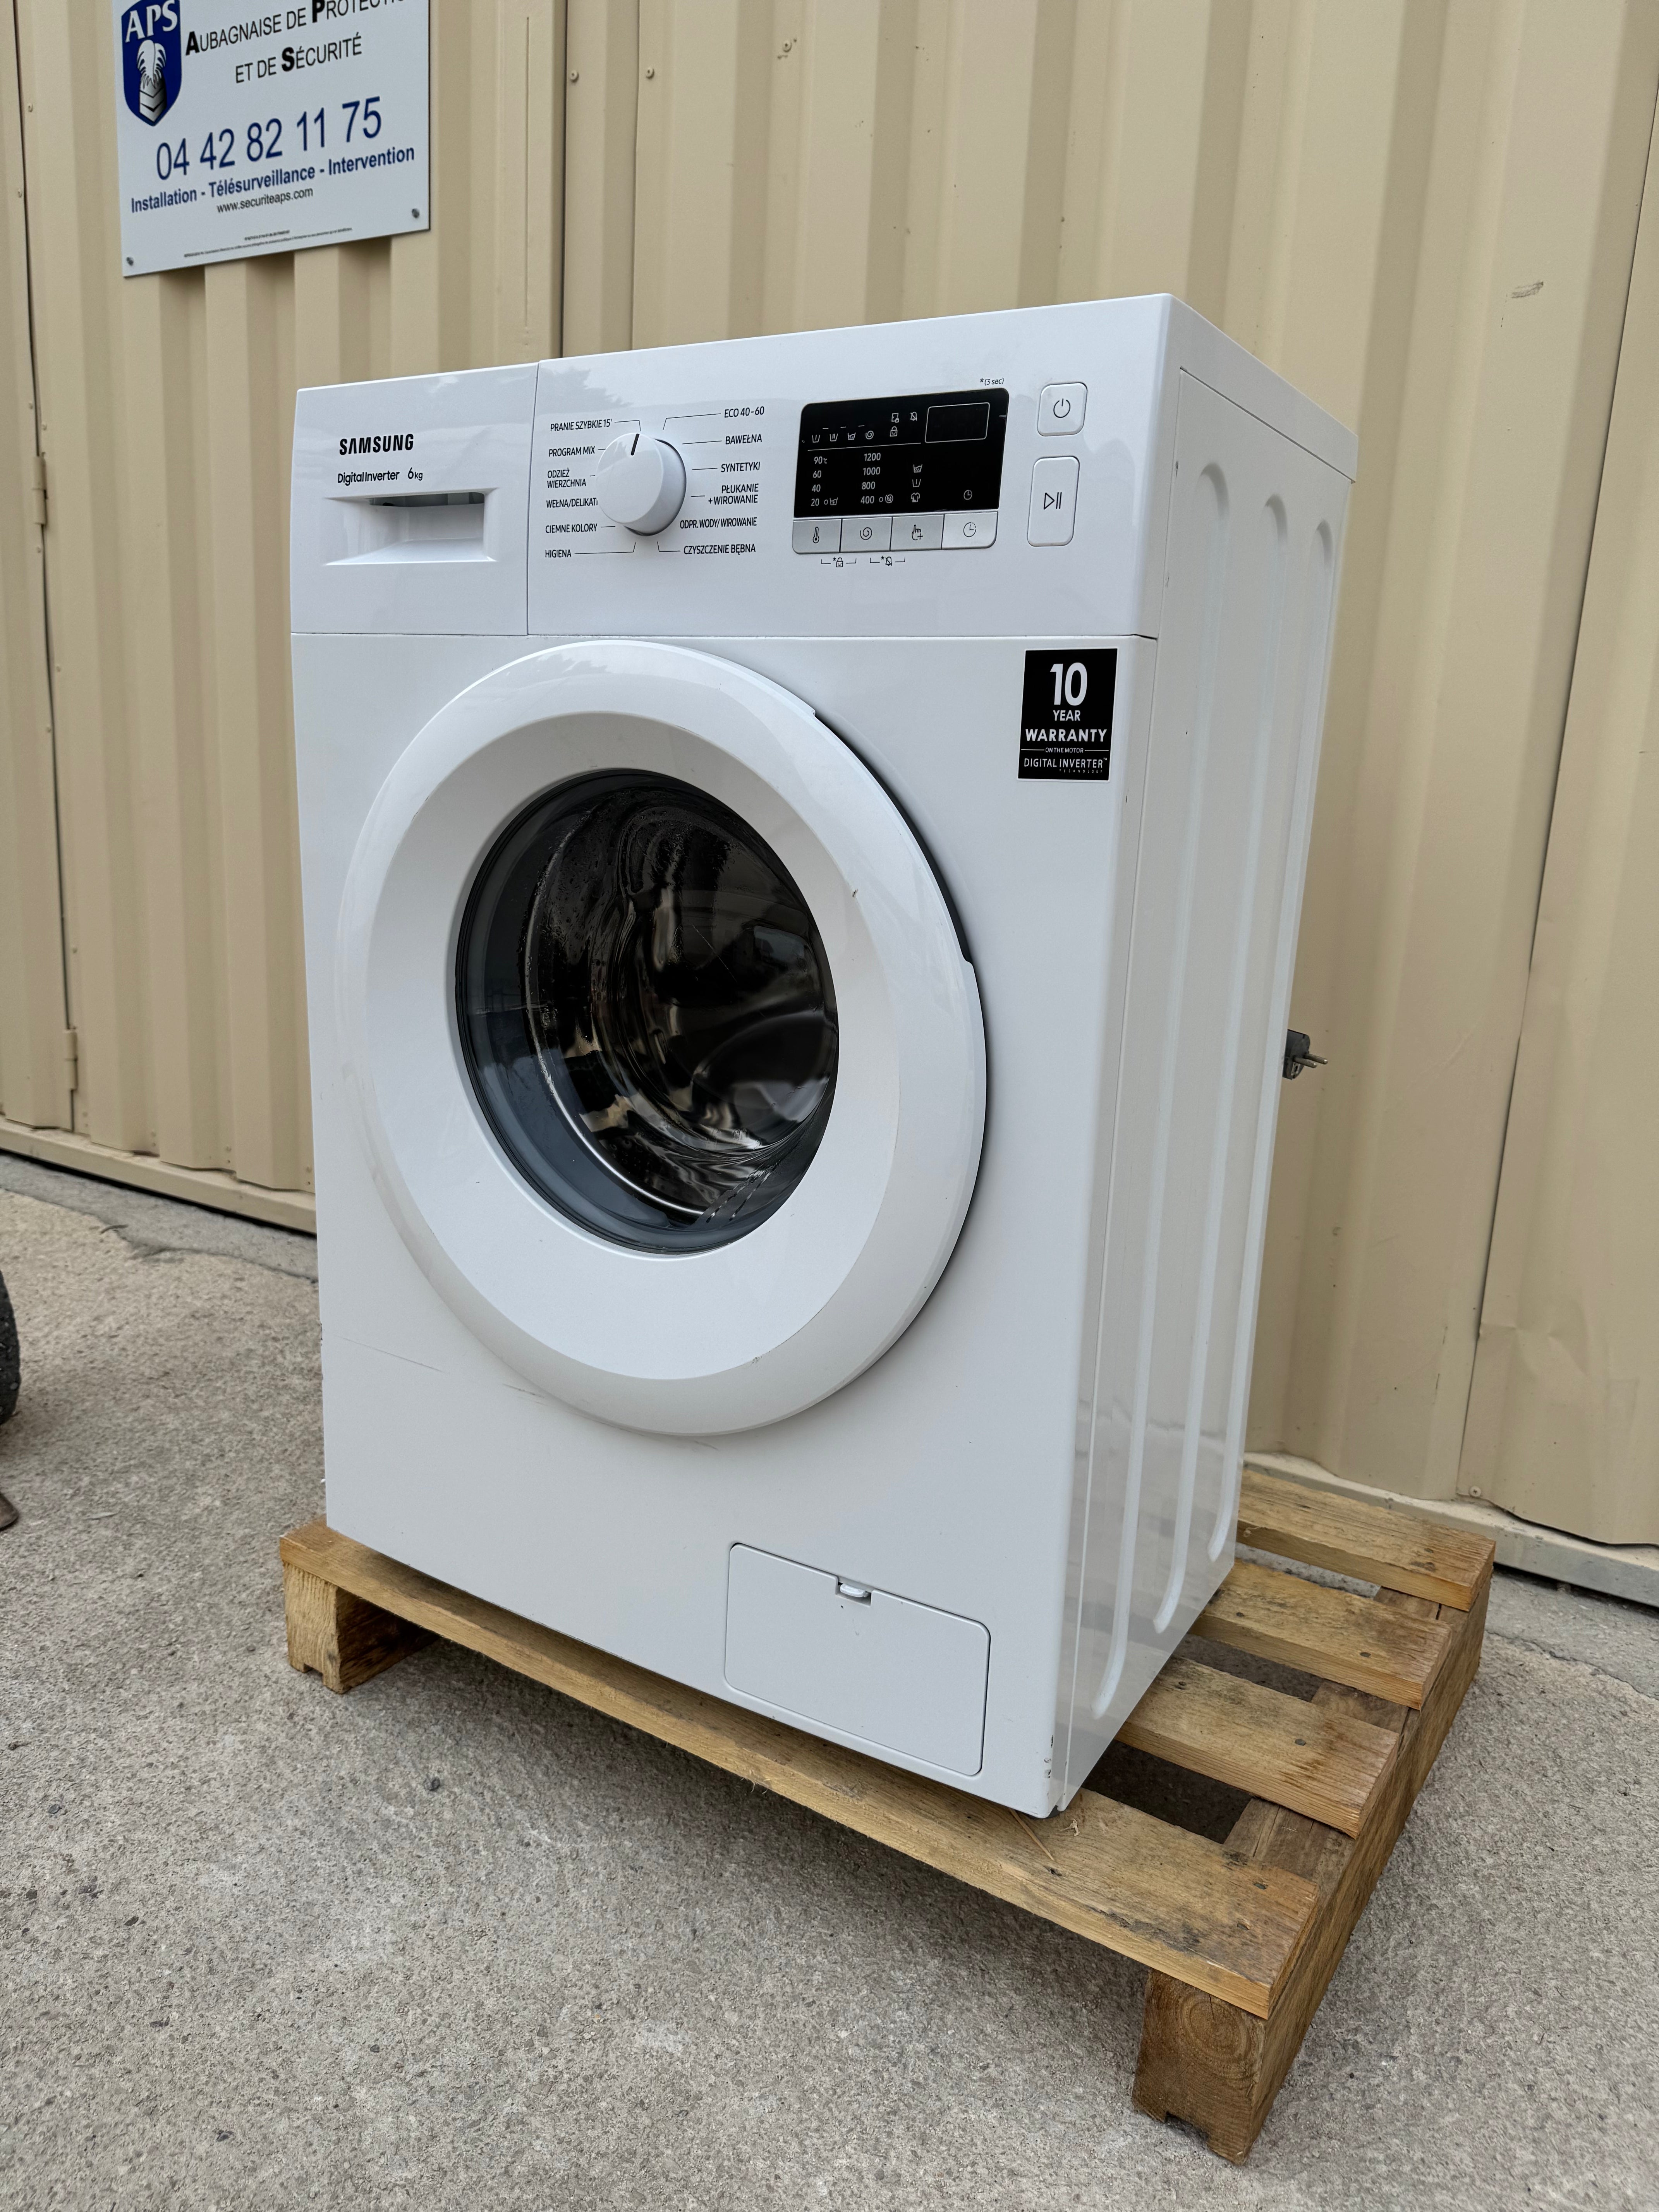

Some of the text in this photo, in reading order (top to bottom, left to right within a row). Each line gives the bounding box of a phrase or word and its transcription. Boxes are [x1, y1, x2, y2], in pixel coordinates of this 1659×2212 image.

[125, 0, 178, 43] APS
[185, 14, 282, 55] AUBAGNAISE
[287, 7, 307, 29] DE
[236, 32, 362, 83] ET DE SÉCURITÉ
[156, 96, 382, 181] 04 42 82 11 75
[131, 188, 197, 213] Installation
[208, 167, 316, 198] Télésurveillance
[328, 146, 415, 176] Intervention
[217, 187, 313, 213] www.securiteaps.com
[724, 409, 739, 418] ECO
[550, 422, 574, 431] PRANIE
[575, 419, 603, 430] SZYBKIE
[339, 433, 414, 455] SAMSUNG
[725, 434, 762, 445] BAWEŁNA
[549, 446, 595, 457] PROGRAM MIX
[864, 453, 881, 461] 1200
[548, 467, 570, 478] ODZIEŻ
[721, 462, 760, 472] SYNTETYKI
[863, 467, 881, 476] 1000
[813, 470, 822, 478] 60
[547, 478, 586, 488] WIERZCHNIA
[721, 483, 759, 493] PŁUKANIE
[812, 484, 821, 492] 40
[862, 481, 875, 490] 800
[811, 498, 819, 506] 20
[860, 496, 874, 504] 400
[545, 523, 598, 533] CIEMNE KOLORY
[545, 549, 571, 558] HIGIENA
[684, 543, 756, 555] CZYSZCZENIE BĘBNA
[1050, 662, 1087, 706] 10
[1053, 710, 1080, 721] YEAR
[1025, 728, 1107, 742] WARRANTY
[1024, 758, 1057, 767] DIGITAL
